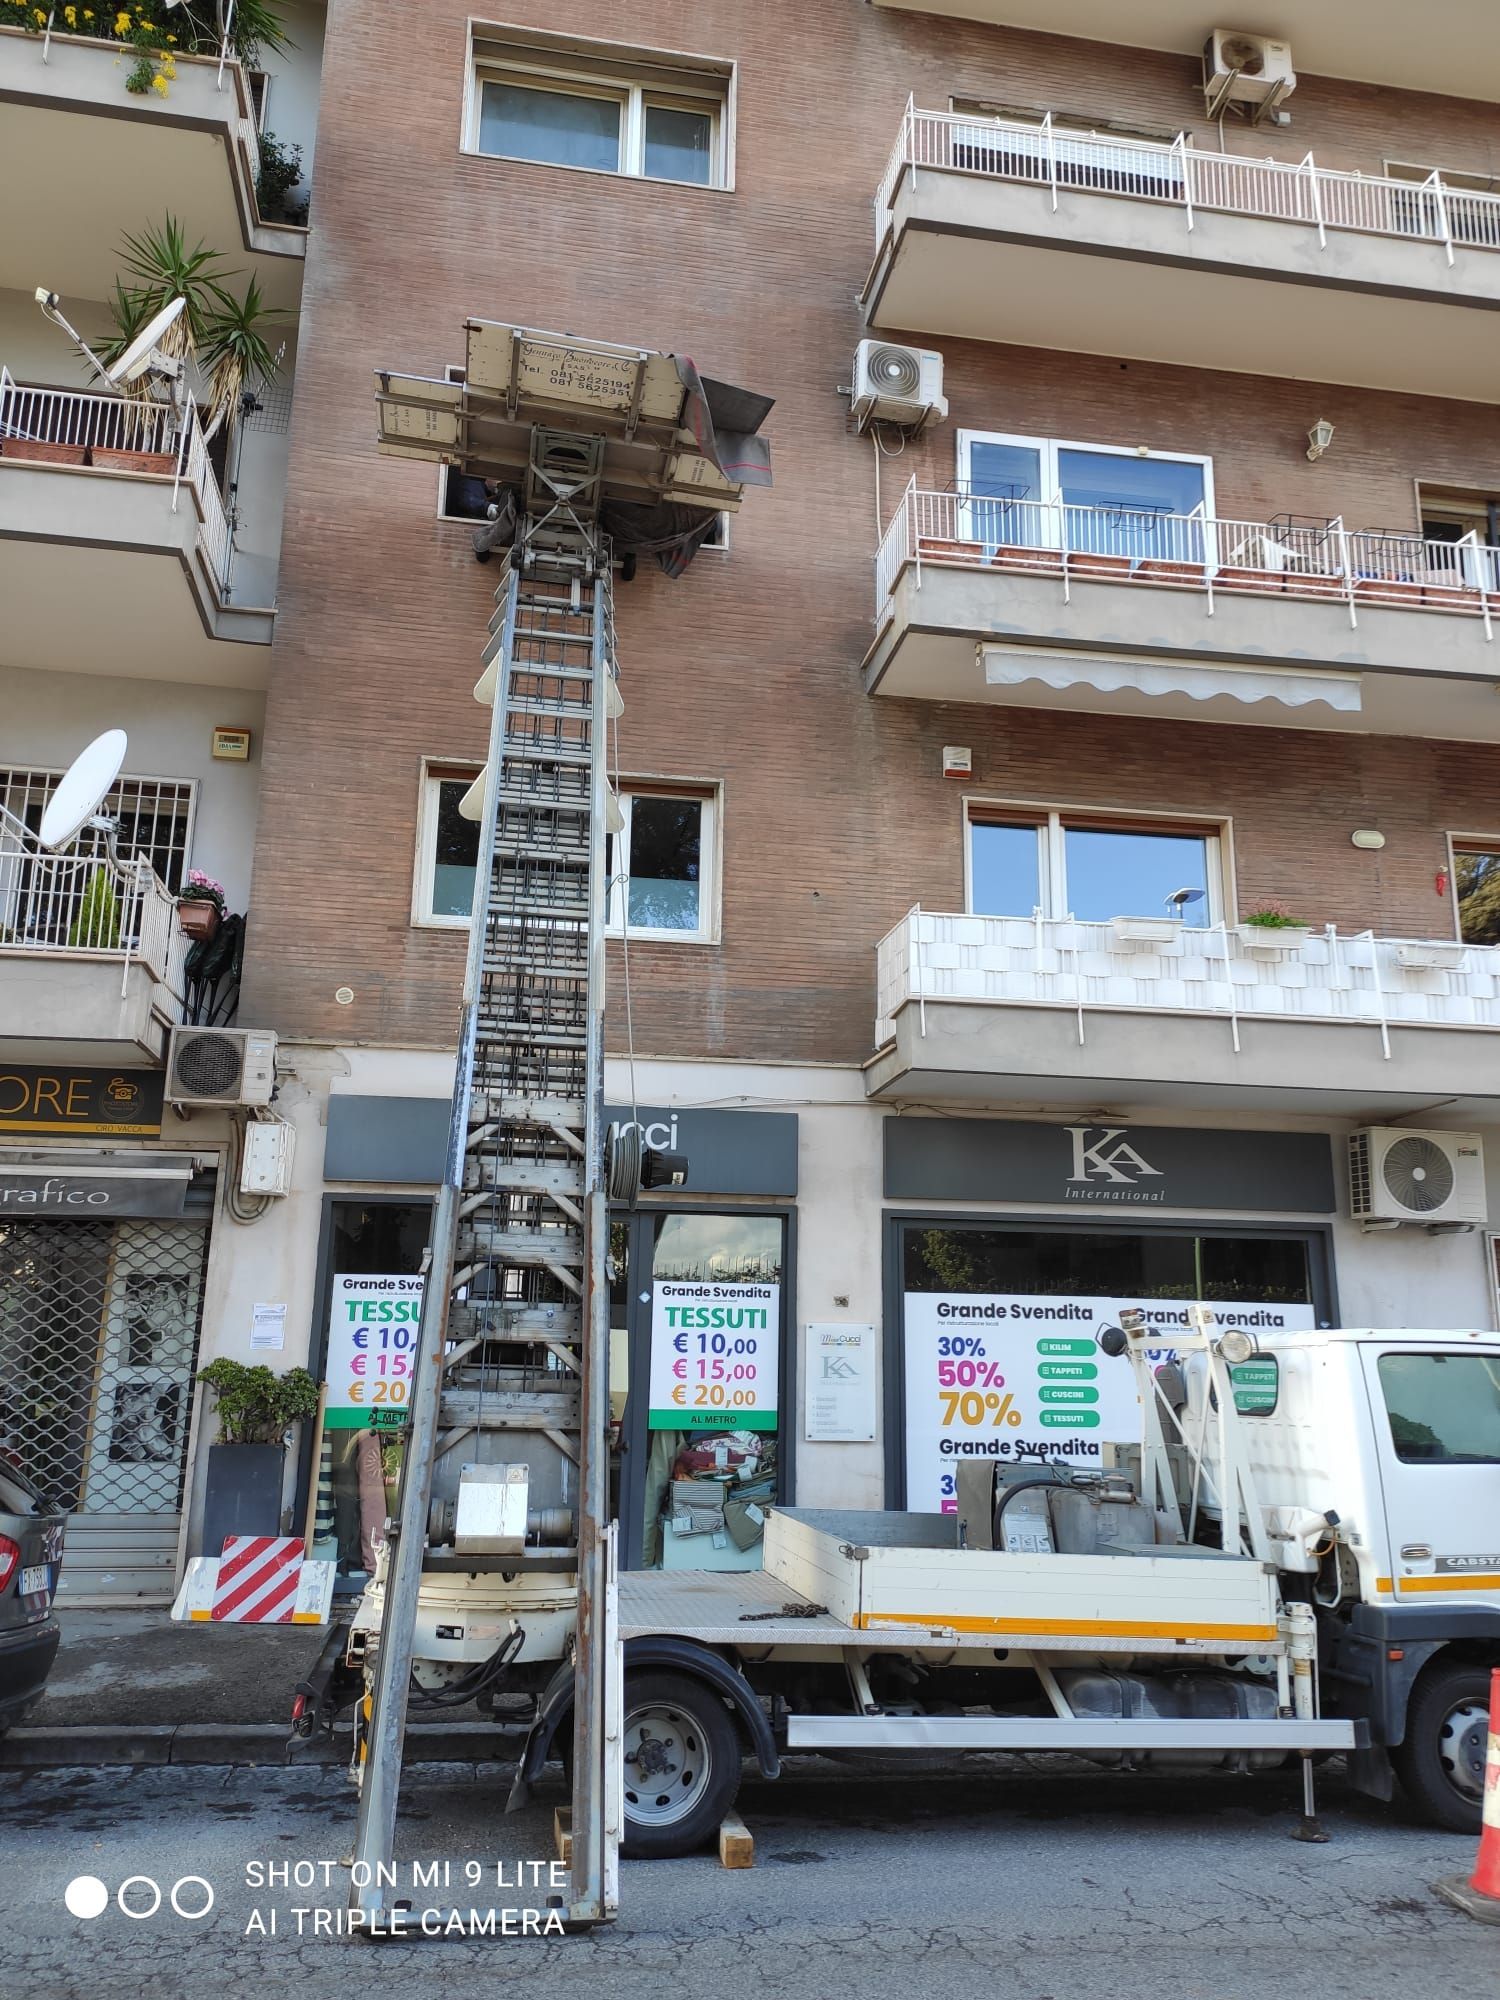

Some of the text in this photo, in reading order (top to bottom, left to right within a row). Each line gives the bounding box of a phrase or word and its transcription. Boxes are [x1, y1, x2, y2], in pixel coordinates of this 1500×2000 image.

[1063, 1127, 1164, 1183] KA
[0, 1179, 110, 1205] rafico
[1065, 1187, 1165, 1201] International
[343, 1279, 396, 1291] Grande
[662, 1286, 771, 1299] Grande Svendita
[665, 1307, 766, 1329] TESSUTI
[937, 1303, 1093, 1320] Grande Svendita
[1136, 1308, 1285, 1327] Grand vendita
[352, 1328, 369, 1349] €
[673, 1332, 757, 1357] € 10,00
[938, 1336, 986, 1357] 30%
[350, 1354, 367, 1375] €
[672, 1358, 757, 1382] € 15,00
[938, 1360, 1005, 1388] 50%
[1050, 1367, 1083, 1375] TAPPETI
[348, 1381, 365, 1403] €
[671, 1384, 756, 1408] € 20,00
[1052, 1391, 1085, 1399] CUSCINI
[938, 1391, 1022, 1427] 70%
[691, 1416, 737, 1424] AL METRO
[939, 1438, 1099, 1456] Grande Svendita
